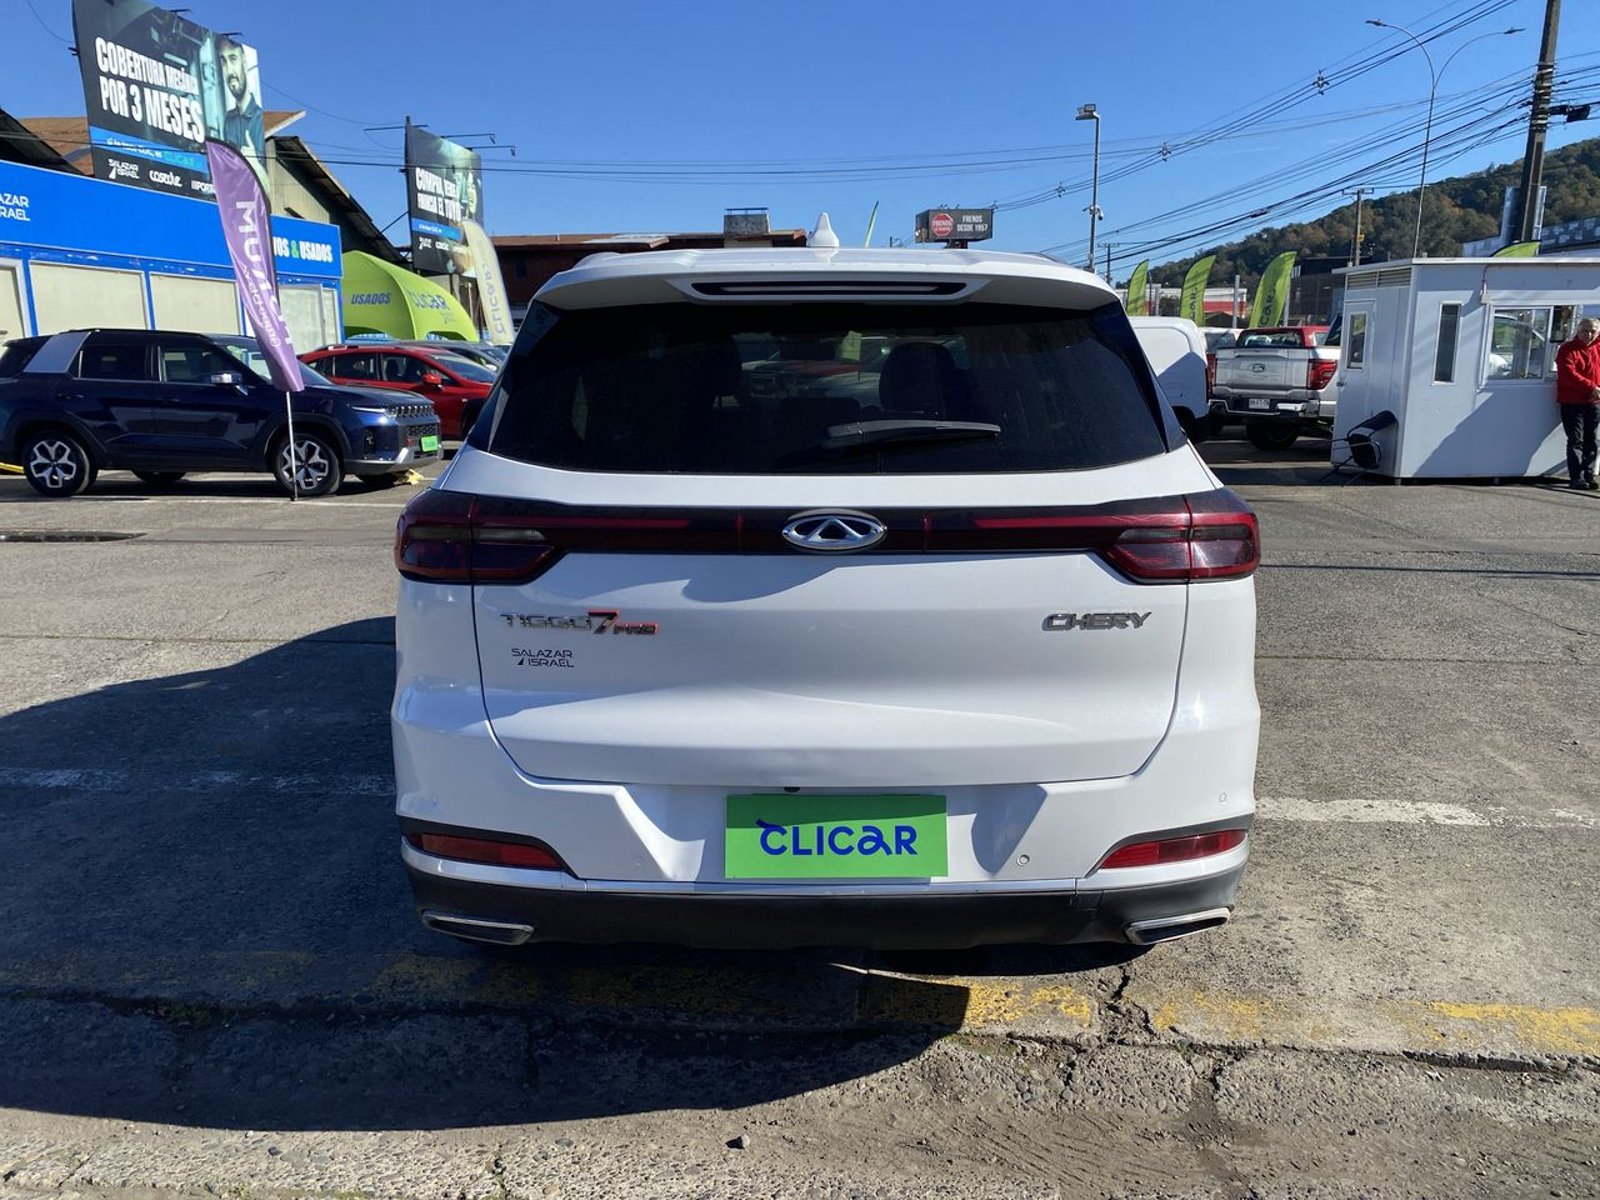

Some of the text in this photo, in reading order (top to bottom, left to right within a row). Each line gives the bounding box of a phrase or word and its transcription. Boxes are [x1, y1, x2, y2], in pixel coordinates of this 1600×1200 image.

[95, 37, 166, 87] COBERTURA
[100, 76, 205, 143] POR 3 MESES
[299, 241, 333, 263] USADOS
[351, 293, 391, 305] USADOS
[501, 610, 661, 636] TIGGO 7 PRO
[1042, 611, 1153, 632] CHERY
[511, 648, 574, 658] SALAZAR
[528, 658, 575, 668] ISRAEL
